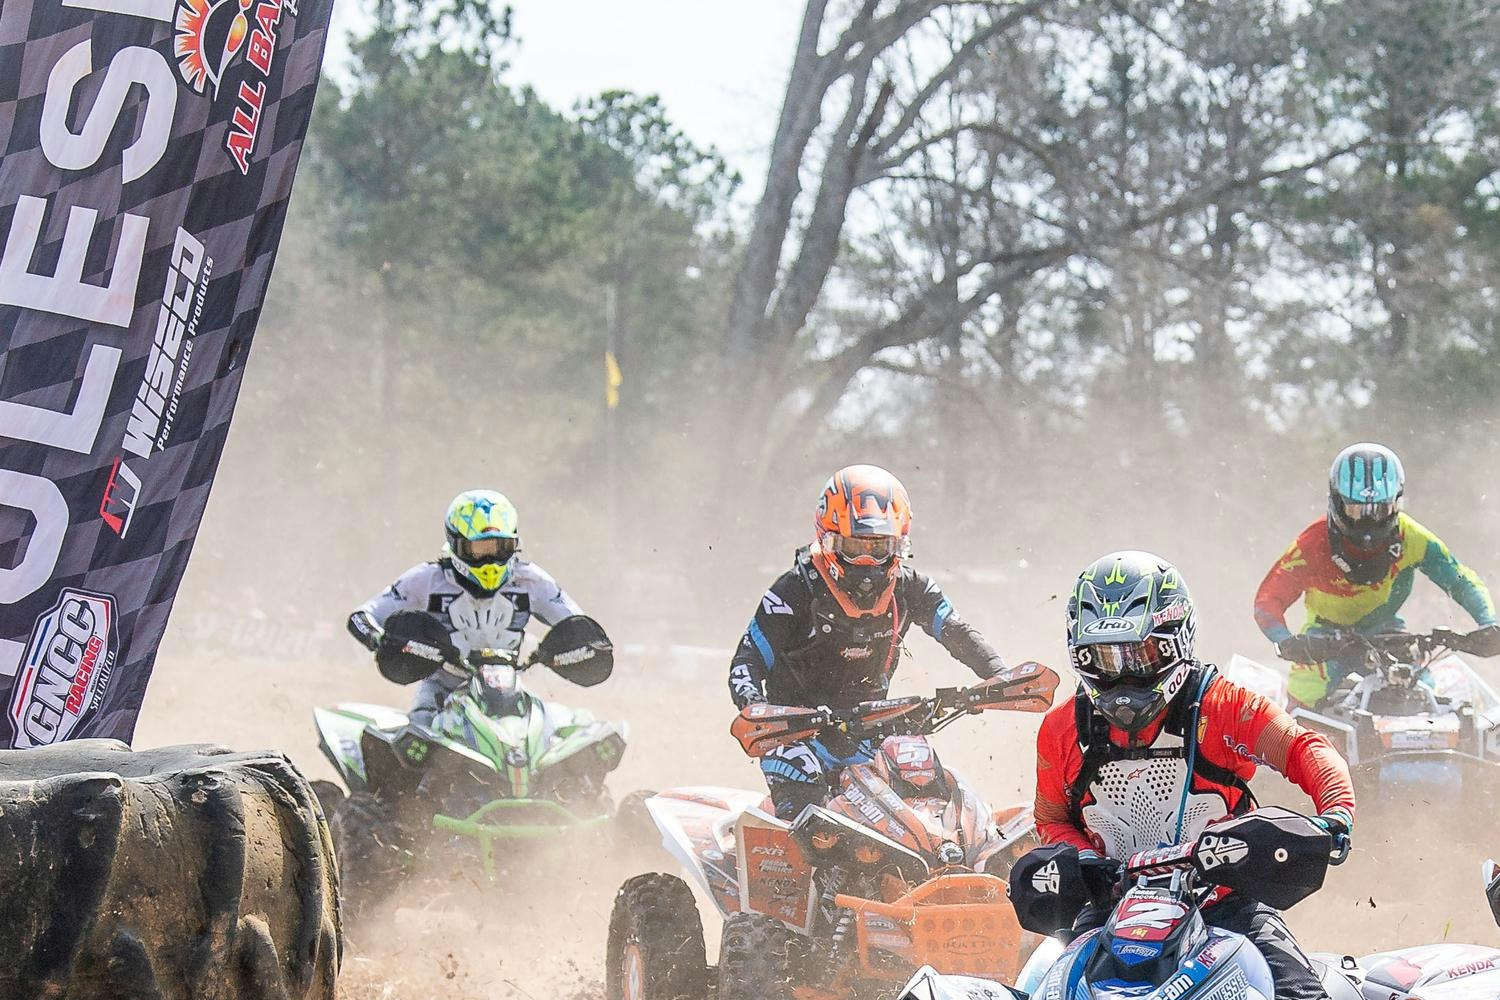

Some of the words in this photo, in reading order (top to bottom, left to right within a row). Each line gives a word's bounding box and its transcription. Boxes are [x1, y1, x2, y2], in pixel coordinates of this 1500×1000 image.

[227, 80, 267, 176] ALL
[121, 225, 206, 460] WISECO
[156, 339, 193, 452] Performance
[187, 255, 214, 336] Products
[1093, 618, 1129, 632] Arai
[24, 598, 96, 747] GNCC
[64, 635, 104, 718] RACING
[90, 650, 117, 713] SPECIALIZED
[896, 740, 931, 764] 5
[751, 846, 787, 857] FXR
[1114, 901, 1188, 930] 2
[1446, 959, 1496, 979] KENDA
